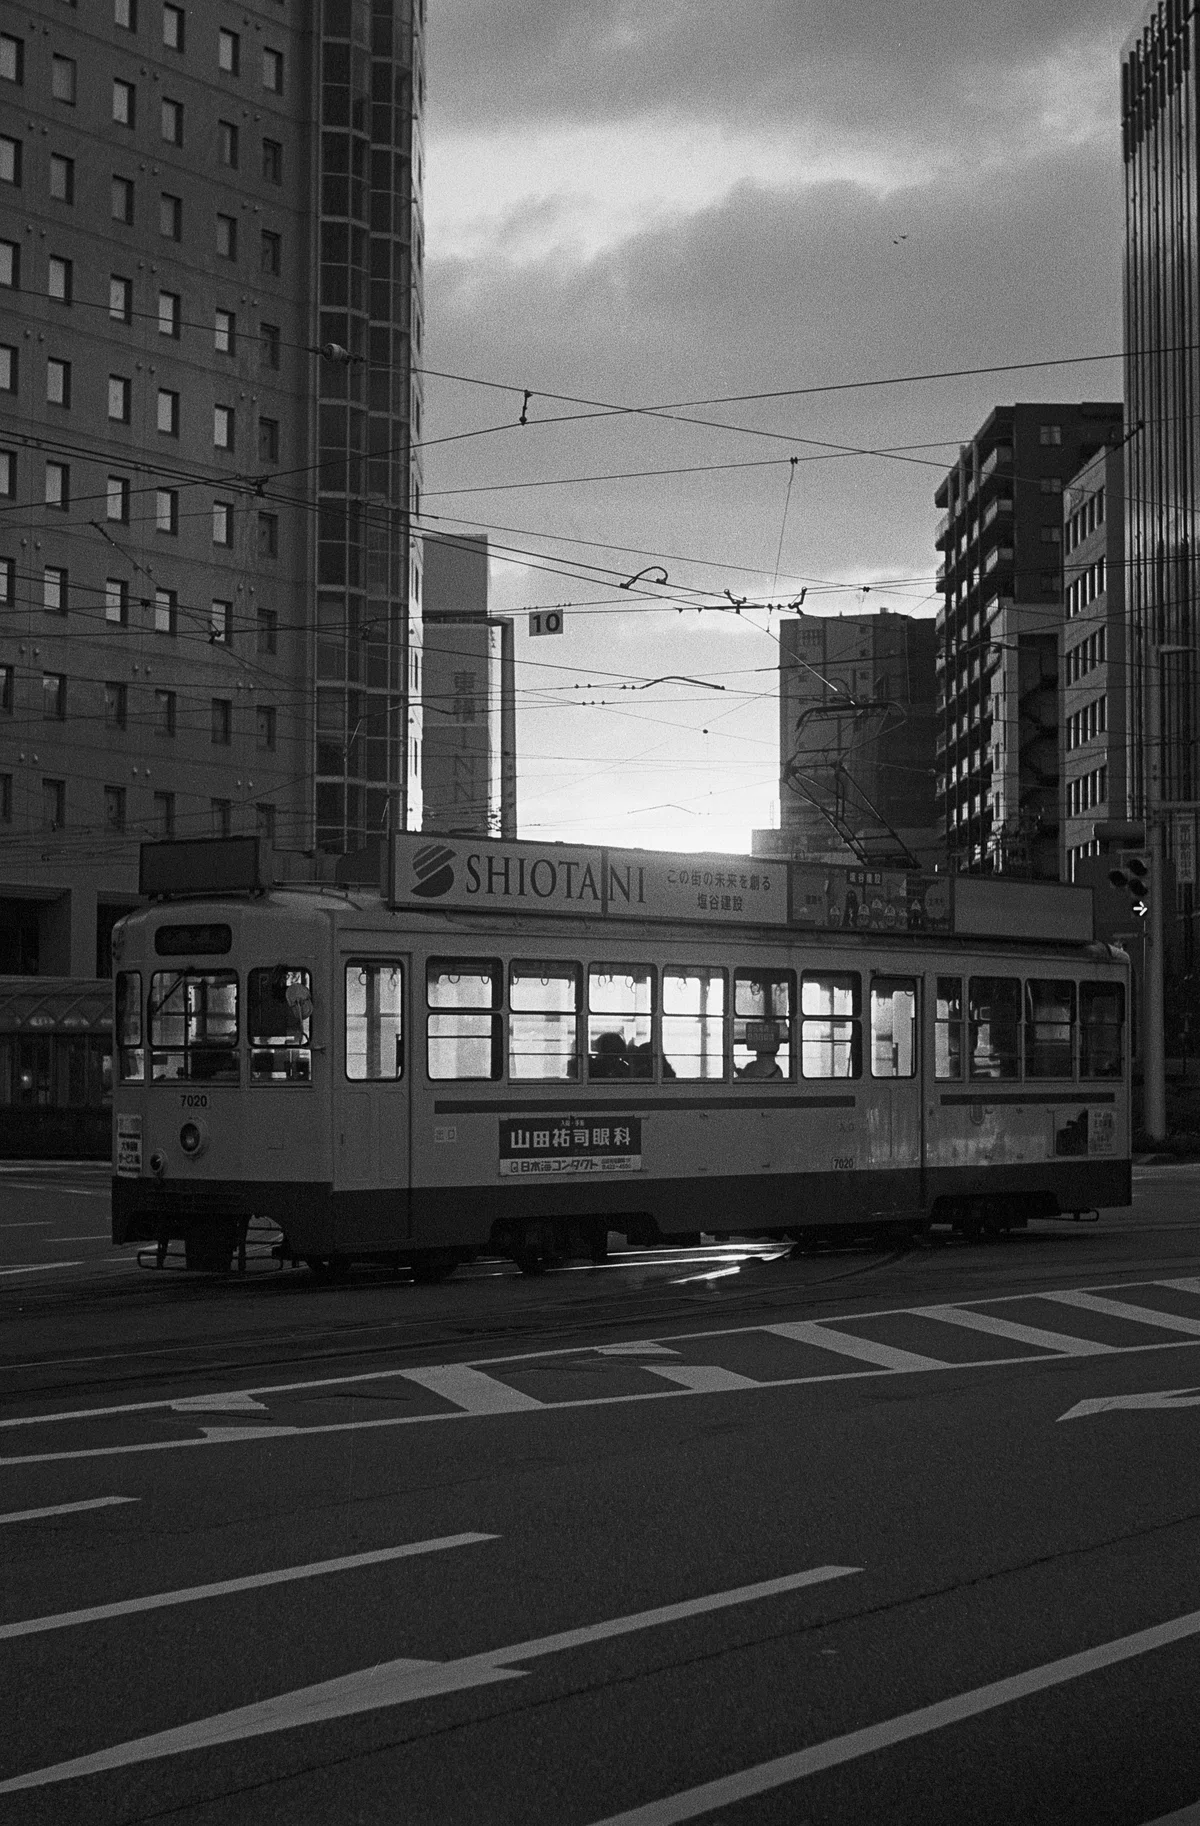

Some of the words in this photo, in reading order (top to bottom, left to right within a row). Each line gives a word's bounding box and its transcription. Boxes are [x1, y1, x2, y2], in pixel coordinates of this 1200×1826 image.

[533, 613, 560, 633] 10
[466, 853, 647, 904] SHIOTANI
[667, 869, 771, 891] この街の未来を創る
[697, 893, 743, 912] 塩谷建設
[180, 1095, 208, 1107] 7020
[510, 1126, 631, 1149] 山田祐司眼科
[520, 1159, 599, 1172] 日本海コンタクト
[833, 1158, 854, 1169] 7020
